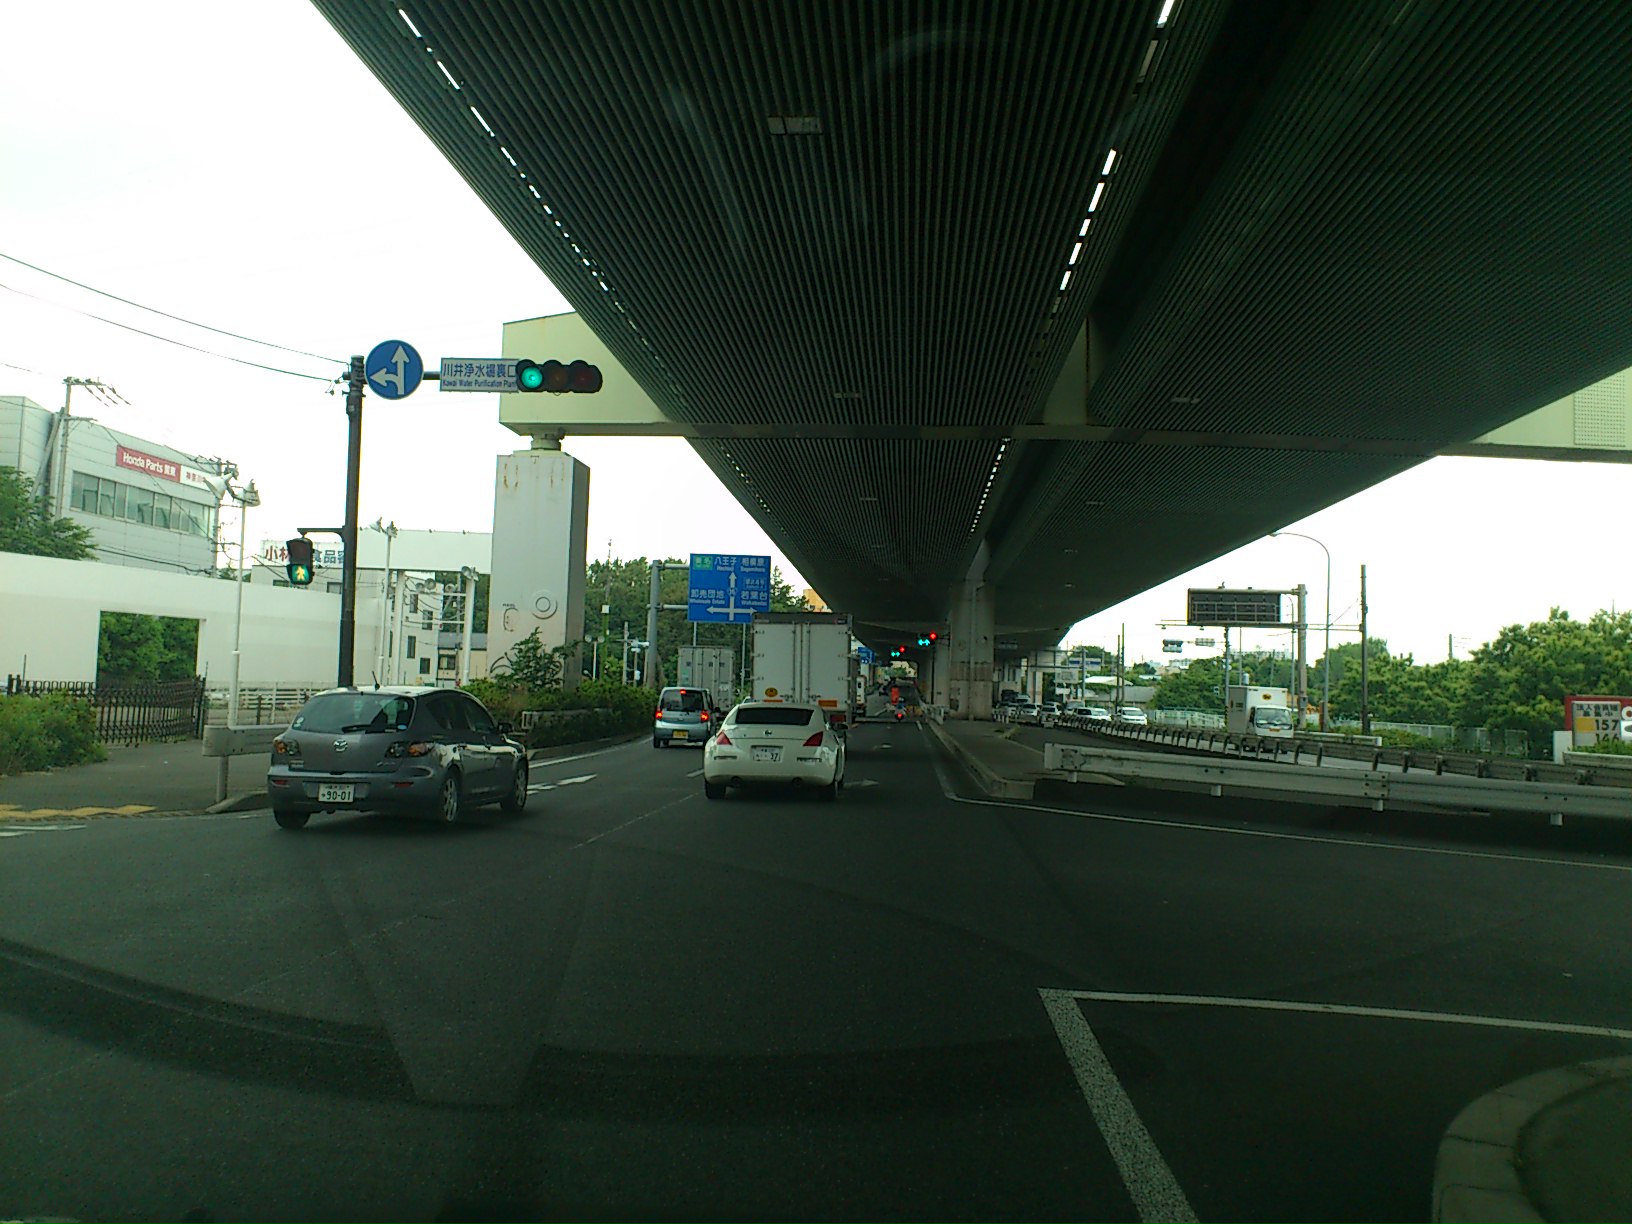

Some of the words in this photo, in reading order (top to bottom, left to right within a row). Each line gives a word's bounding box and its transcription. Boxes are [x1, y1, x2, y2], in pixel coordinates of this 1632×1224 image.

[443, 363, 516, 378] 川井浄水場裏口
[475, 380, 502, 388] Purification
[123, 452, 145, 468] Honda
[146, 459, 163, 473] Parts
[714, 556, 737, 565] 八王子
[742, 557, 765, 566] 相模原
[690, 589, 725, 599] 卸売団地
[741, 591, 768, 600] 若葉台
[1595, 719, 1619, 731] 157
[326, 790, 351, 800] 90-01
